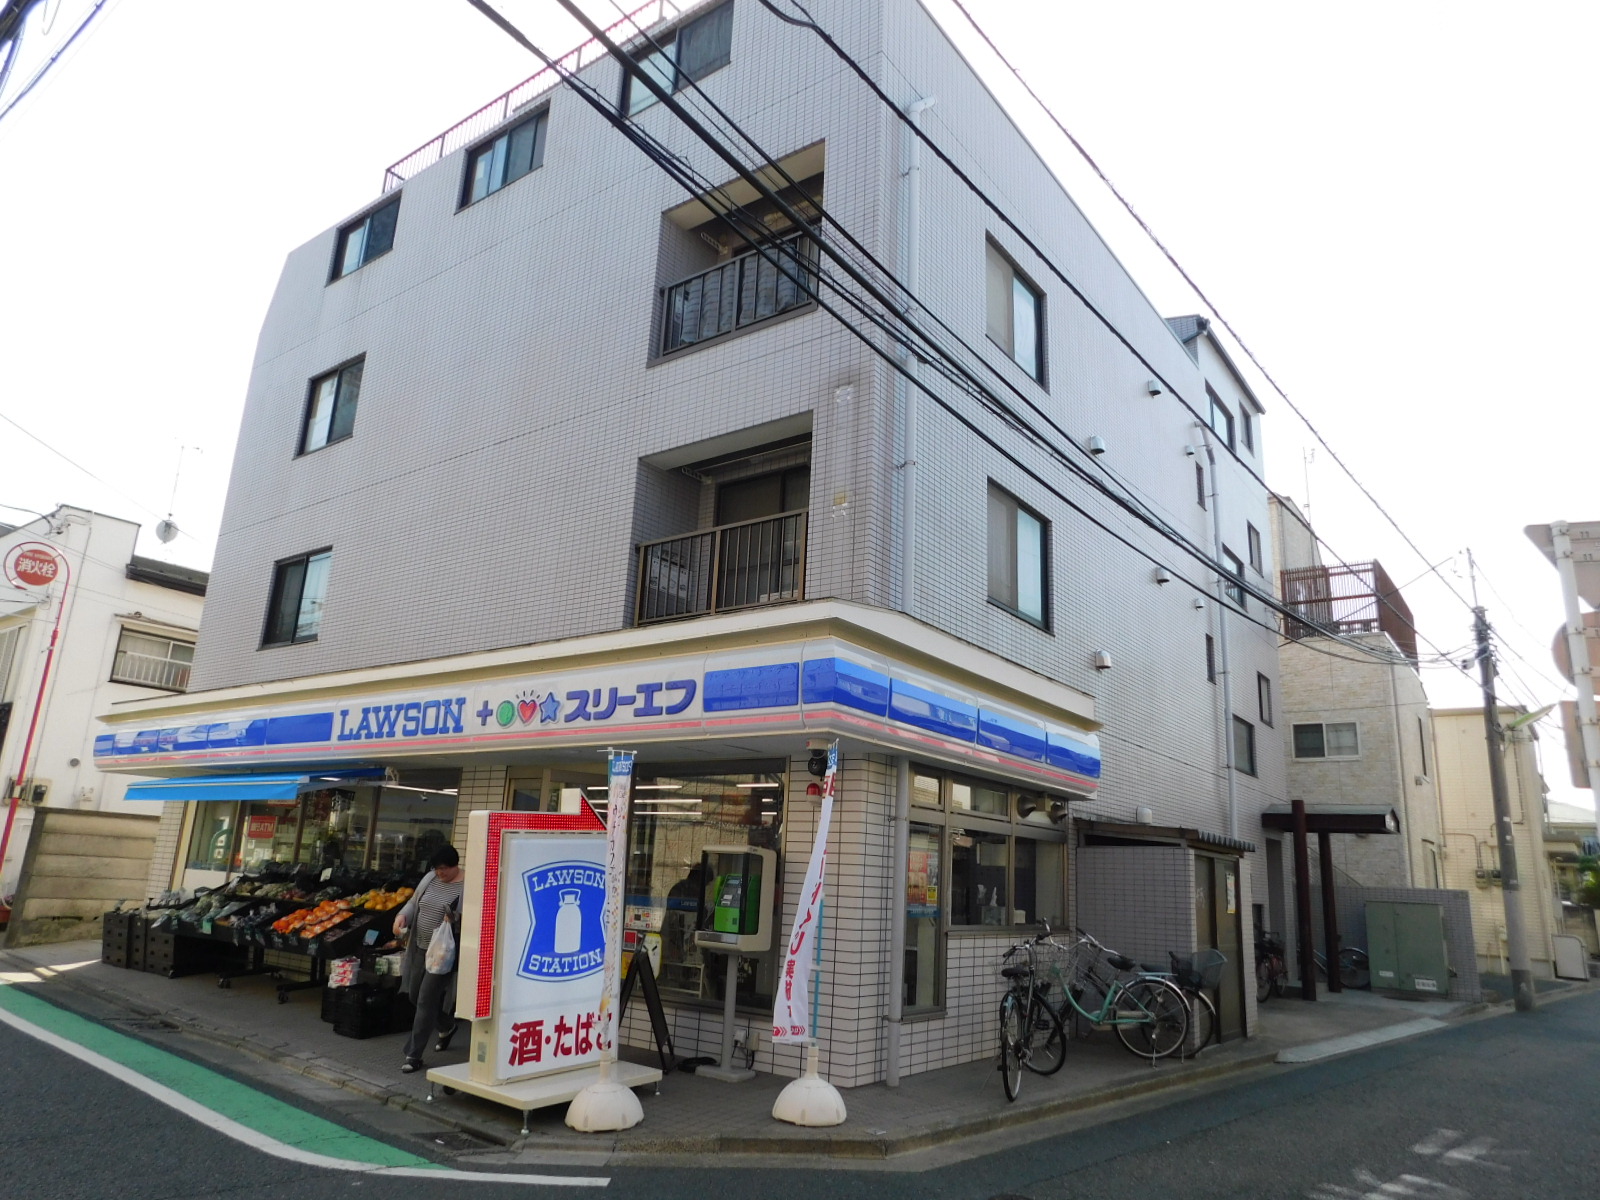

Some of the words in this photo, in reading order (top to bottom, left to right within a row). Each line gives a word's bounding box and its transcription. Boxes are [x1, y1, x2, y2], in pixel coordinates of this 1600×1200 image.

[17, 557, 56, 578] 消火栓
[564, 679, 697, 723] スリーエフ
[337, 697, 466, 741] LAWSON
[532, 869, 605, 892] LAWSON
[528, 948, 602, 973] STATION
